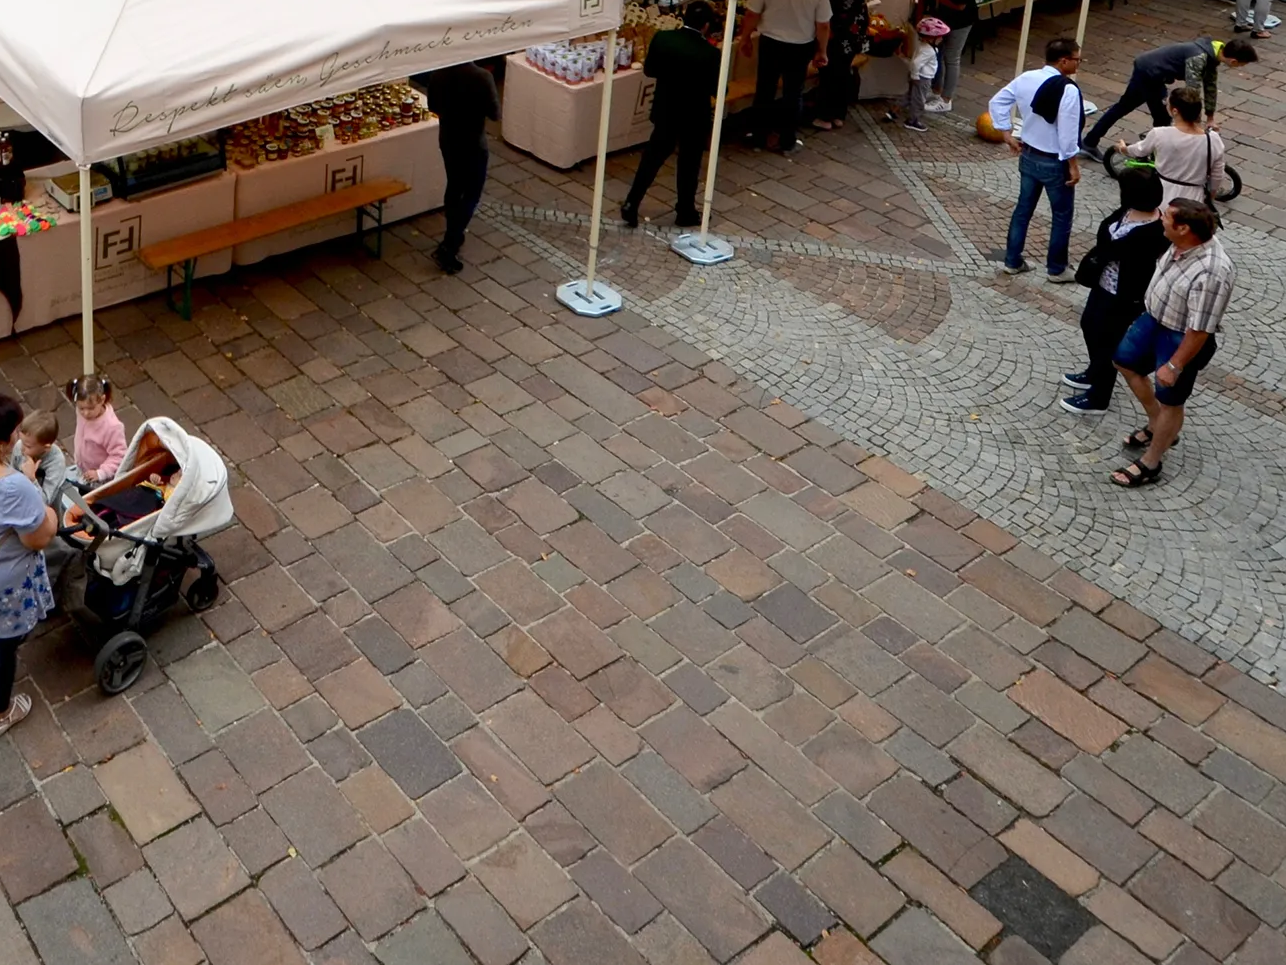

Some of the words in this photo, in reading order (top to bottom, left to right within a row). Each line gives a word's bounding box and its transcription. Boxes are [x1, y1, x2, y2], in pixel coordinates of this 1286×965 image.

[109, 84, 240, 137] Respekt
[244, 74, 308, 98] säen,
[318, 27, 454, 87] Geschmack
[462, 14, 535, 42] ernten
